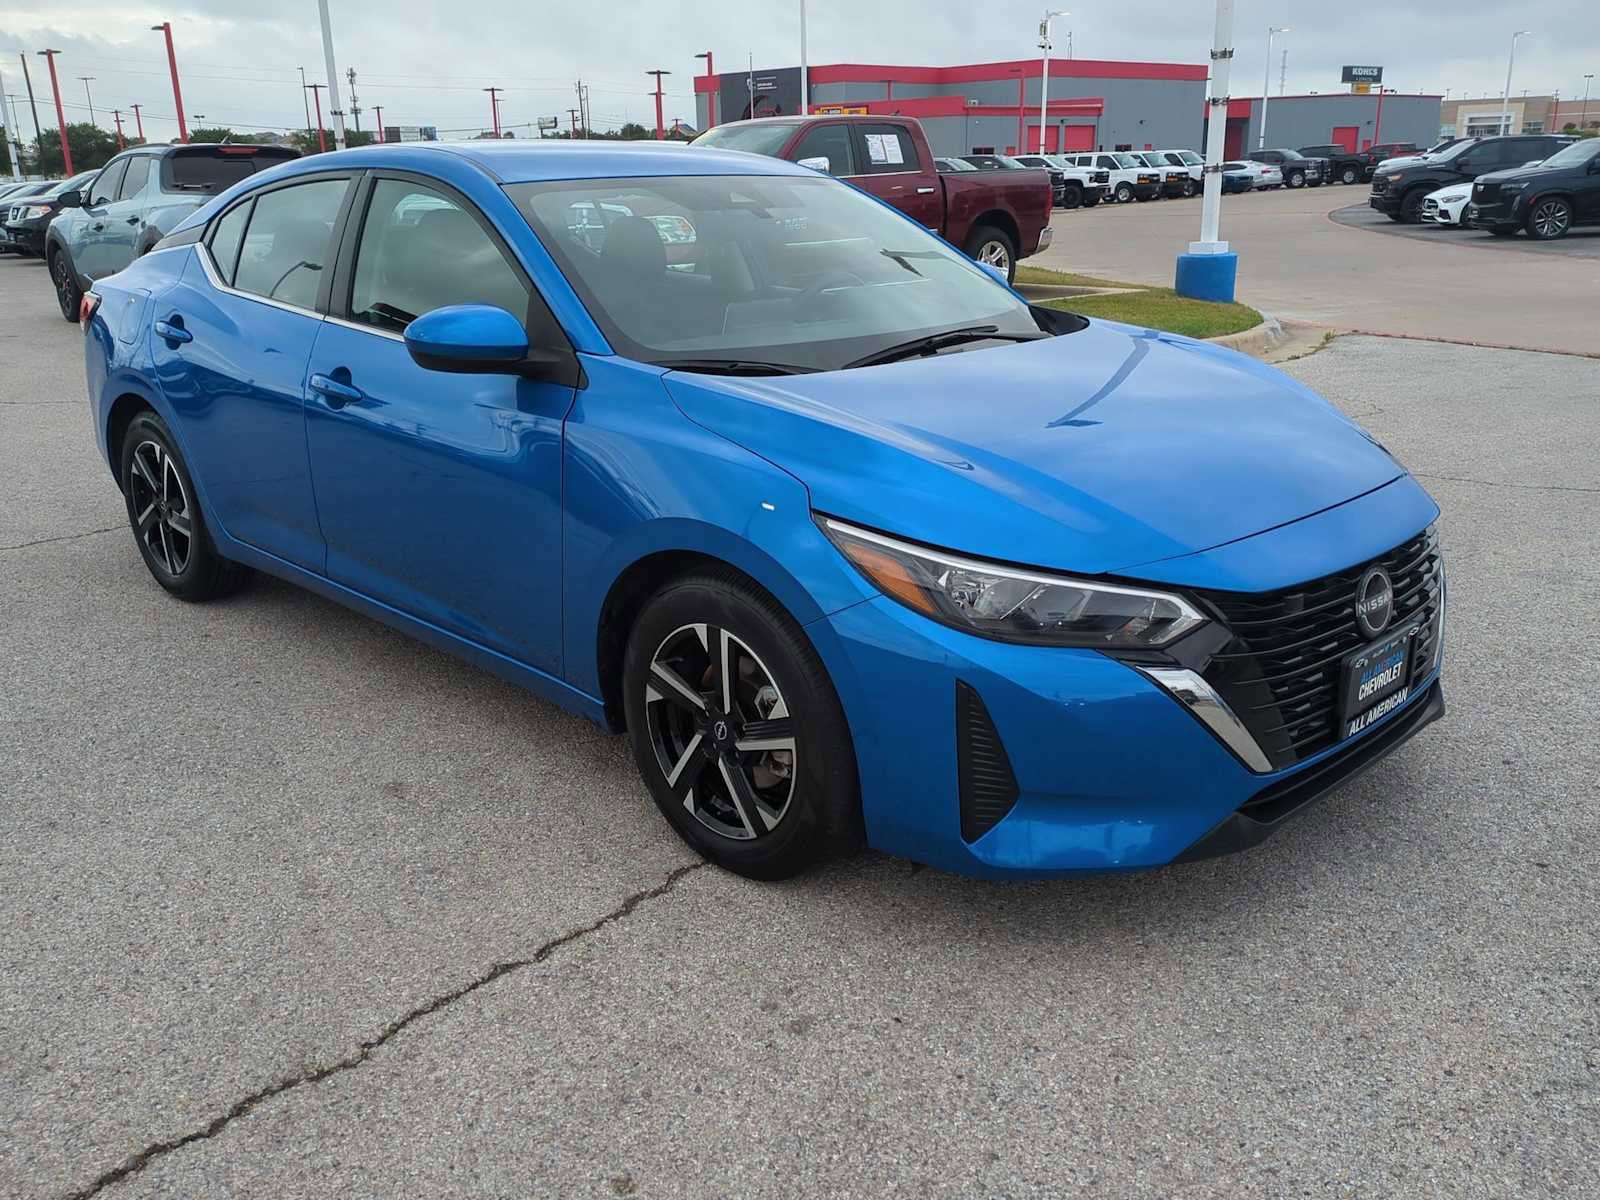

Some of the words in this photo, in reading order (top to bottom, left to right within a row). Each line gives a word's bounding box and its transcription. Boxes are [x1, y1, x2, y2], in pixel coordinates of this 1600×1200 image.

[1358, 661, 1403, 701] CHEVROLET
[1349, 715, 1366, 737] ALL
[1366, 688, 1408, 726] AMERICAN
